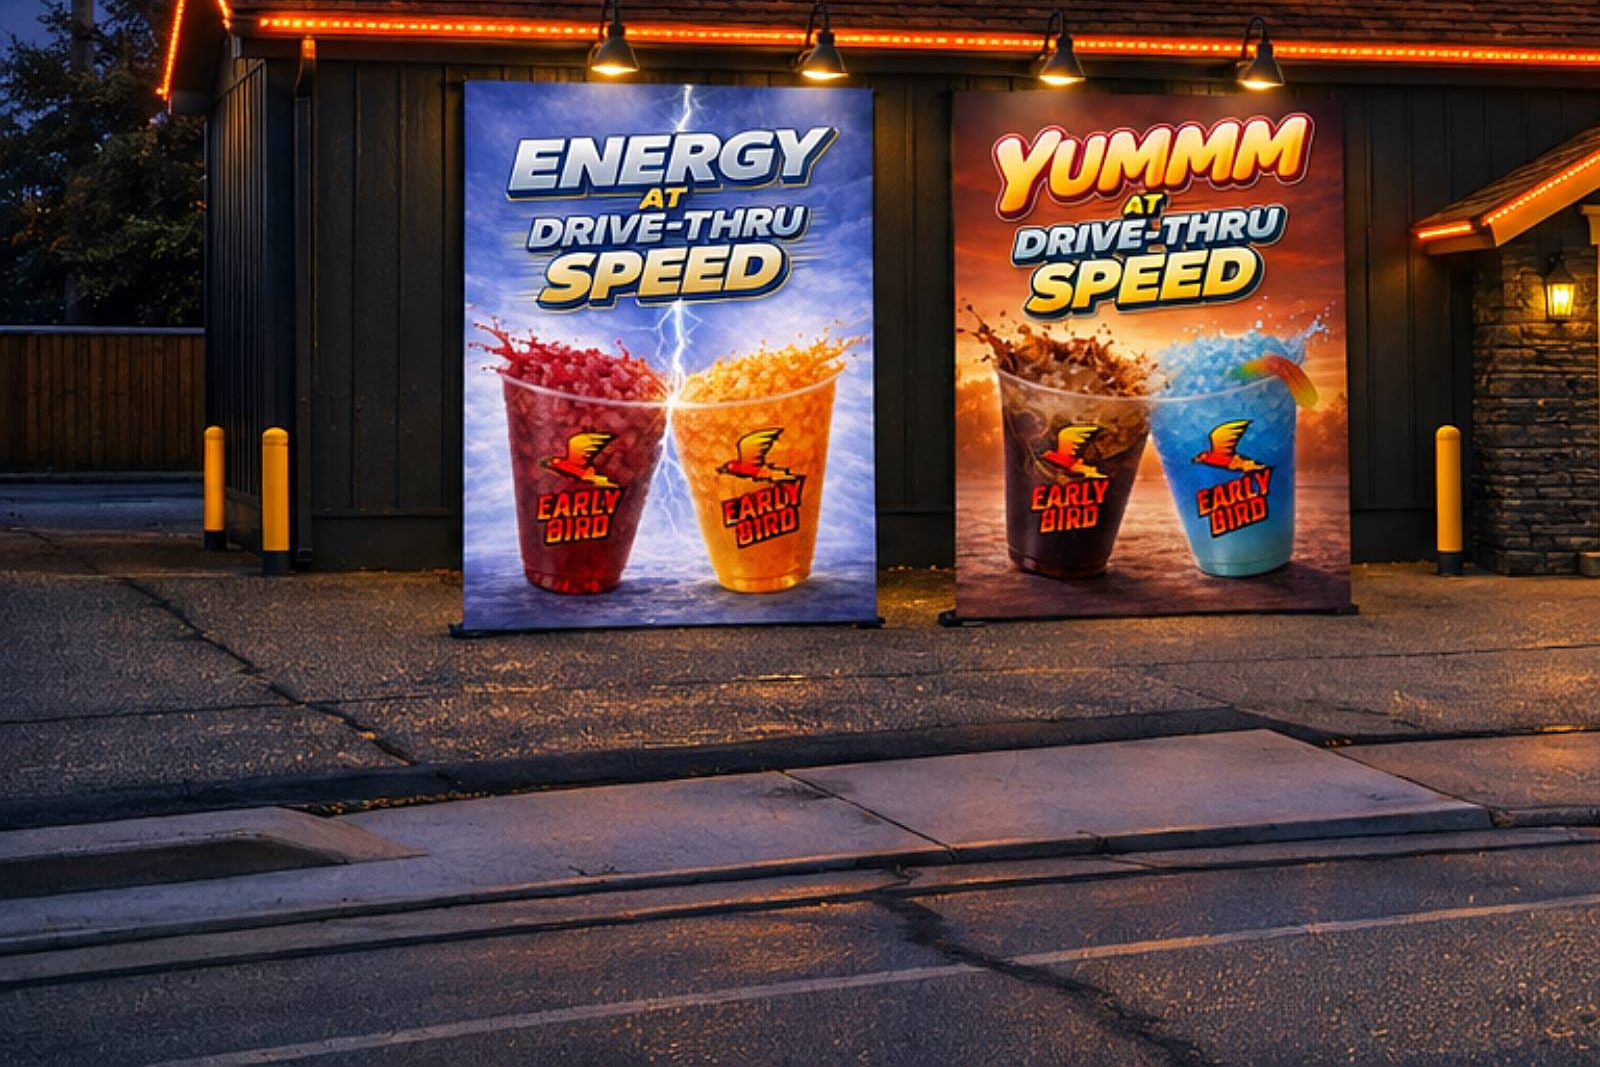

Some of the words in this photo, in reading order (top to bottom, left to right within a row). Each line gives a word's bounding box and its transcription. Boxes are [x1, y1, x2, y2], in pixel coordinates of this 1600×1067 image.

[509, 126, 839, 196] ENERGY
[995, 115, 1309, 215] YUMMM
[639, 186, 688, 210] AT
[1123, 193, 1166, 217] AT
[527, 205, 807, 249] DRIVE-THRU
[1014, 207, 1282, 261] DRIVE-THRU
[538, 243, 786, 305] SPEED
[1026, 249, 1258, 314] SPEED
[537, 489, 622, 520] EARLY
[724, 481, 801, 525] EARLY
[1031, 479, 1109, 511] EARLY
[1198, 469, 1271, 516] EARLY
[546, 514, 610, 544] BIRD
[738, 507, 797, 546] BIRD
[1040, 505, 1099, 533] BIRD
[1211, 496, 1267, 536] BIRD
